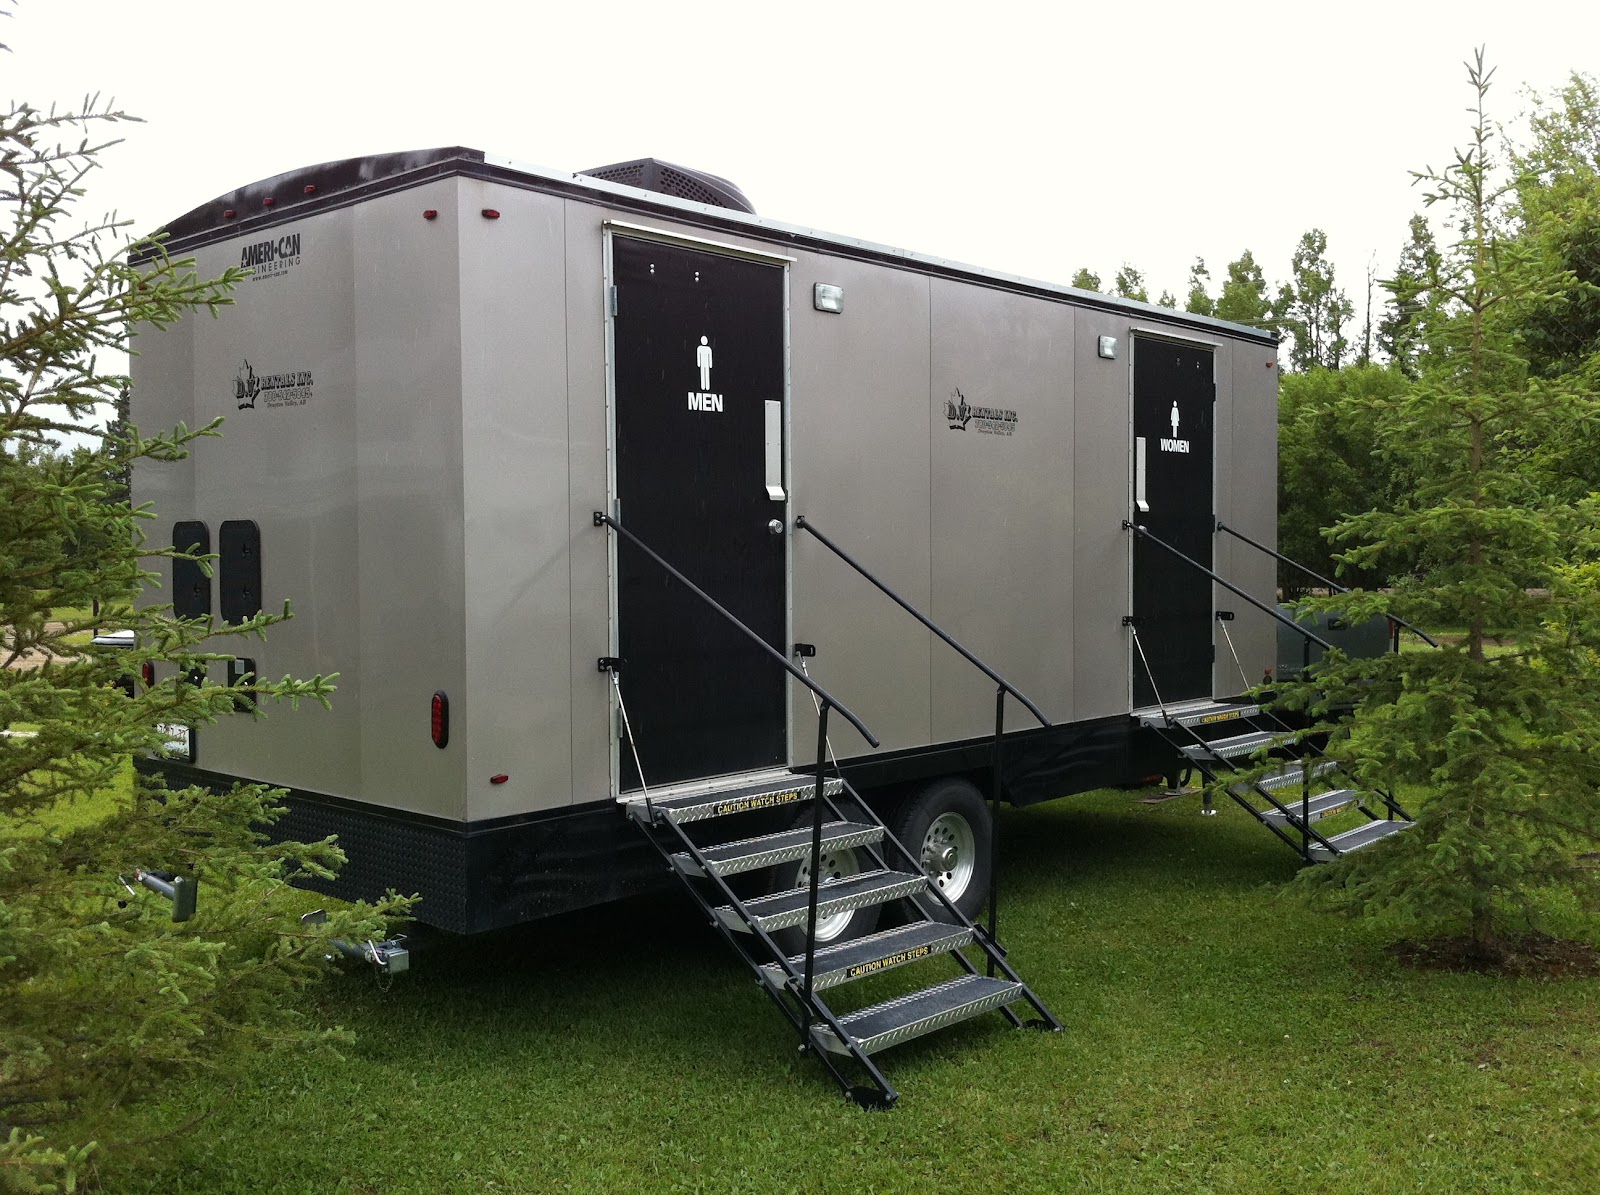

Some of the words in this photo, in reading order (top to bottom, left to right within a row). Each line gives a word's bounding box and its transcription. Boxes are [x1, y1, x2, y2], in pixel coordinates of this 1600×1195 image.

[261, 373, 296, 390] RENTALS
[687, 391, 723, 412] MEN
[972, 406, 1003, 421] RENTALS
[1160, 438, 1190, 453] WOMEN
[717, 800, 750, 814] CAUTION
[750, 796, 775, 808] WATCH
[776, 792, 798, 803] STEPS
[850, 961, 882, 977] CAUTION
[882, 952, 906, 967] WATCH
[907, 946, 929, 960] STEPS
